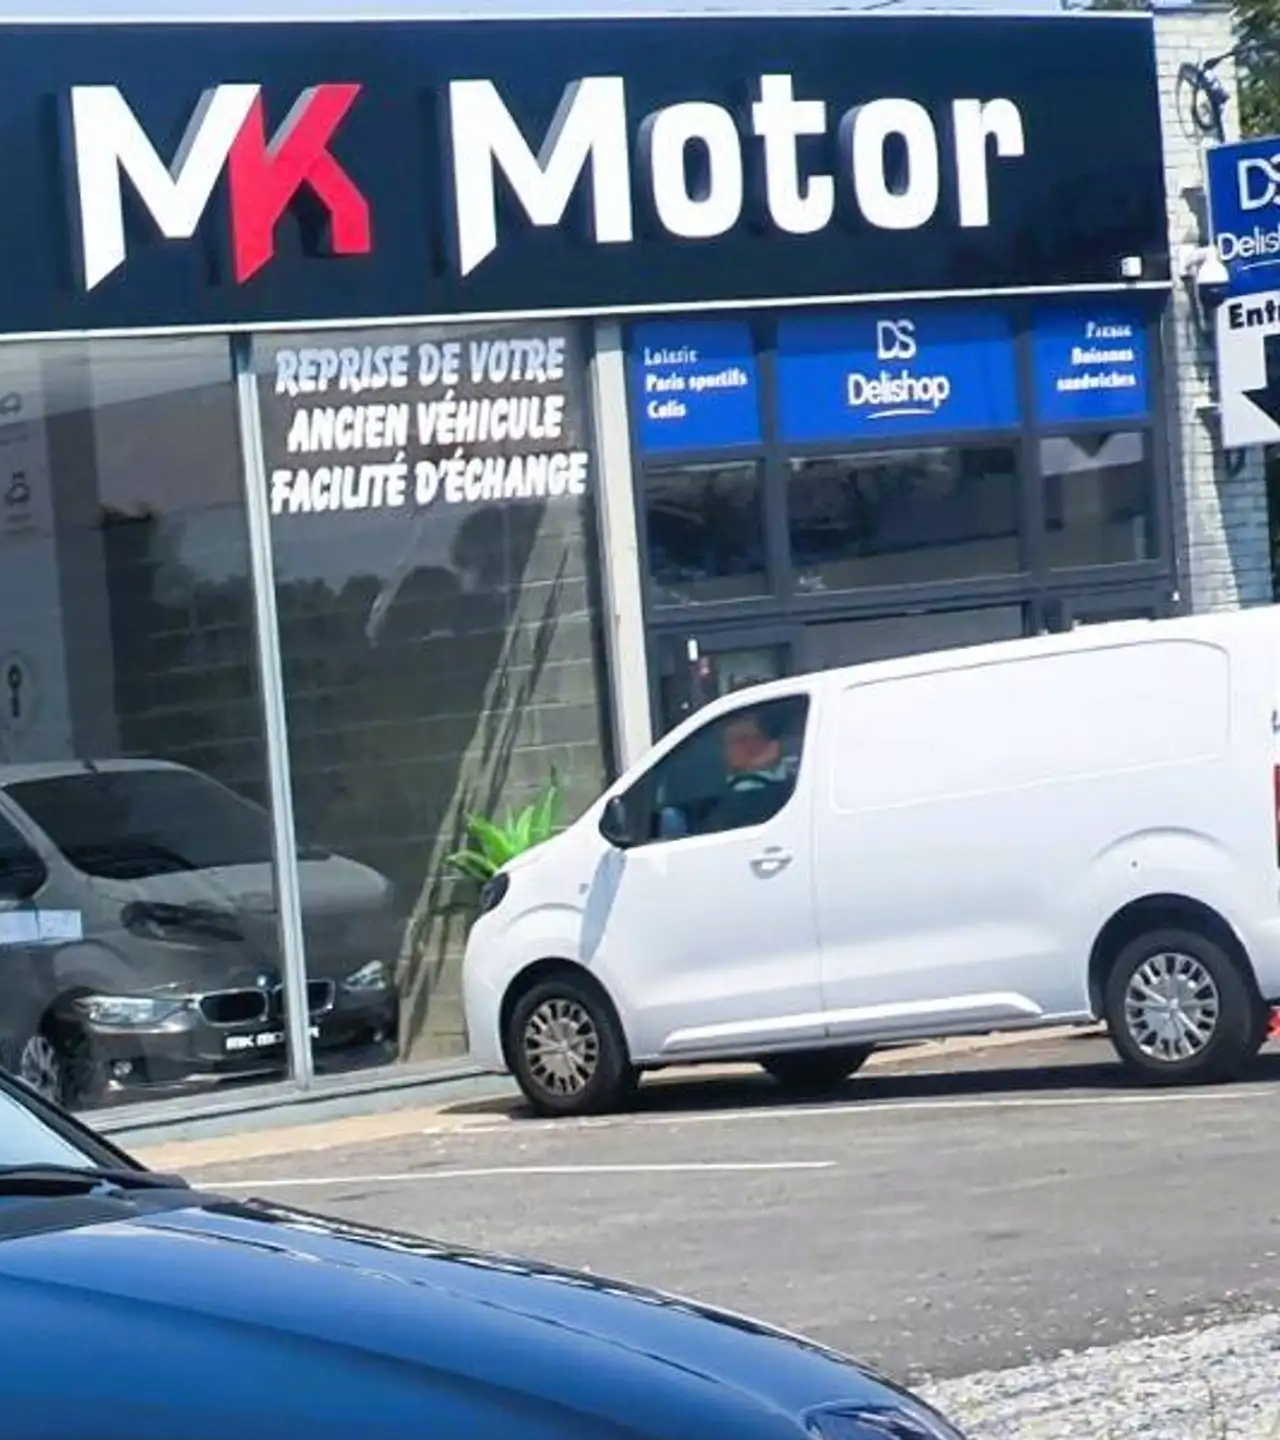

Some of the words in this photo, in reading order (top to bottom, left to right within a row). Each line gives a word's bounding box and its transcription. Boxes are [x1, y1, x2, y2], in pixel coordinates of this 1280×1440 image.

[71, 82, 370, 290] MK
[449, 73, 1024, 278] Motor
[1237, 155, 1280, 211] D
[1217, 222, 1280, 261] Delis
[876, 319, 916, 360] DS
[1228, 296, 1280, 329] Ent
[274, 345, 410, 396] REPRISE
[418, 342, 461, 388] DE
[469, 337, 566, 385] VOTRE
[847, 370, 951, 408] Delishop
[286, 402, 410, 453] ANCIEN
[416, 389, 566, 446] VÉHICULE
[270, 452, 408, 515] FACILITÉ
[414, 447, 589, 506] D'ÉCHANGE
